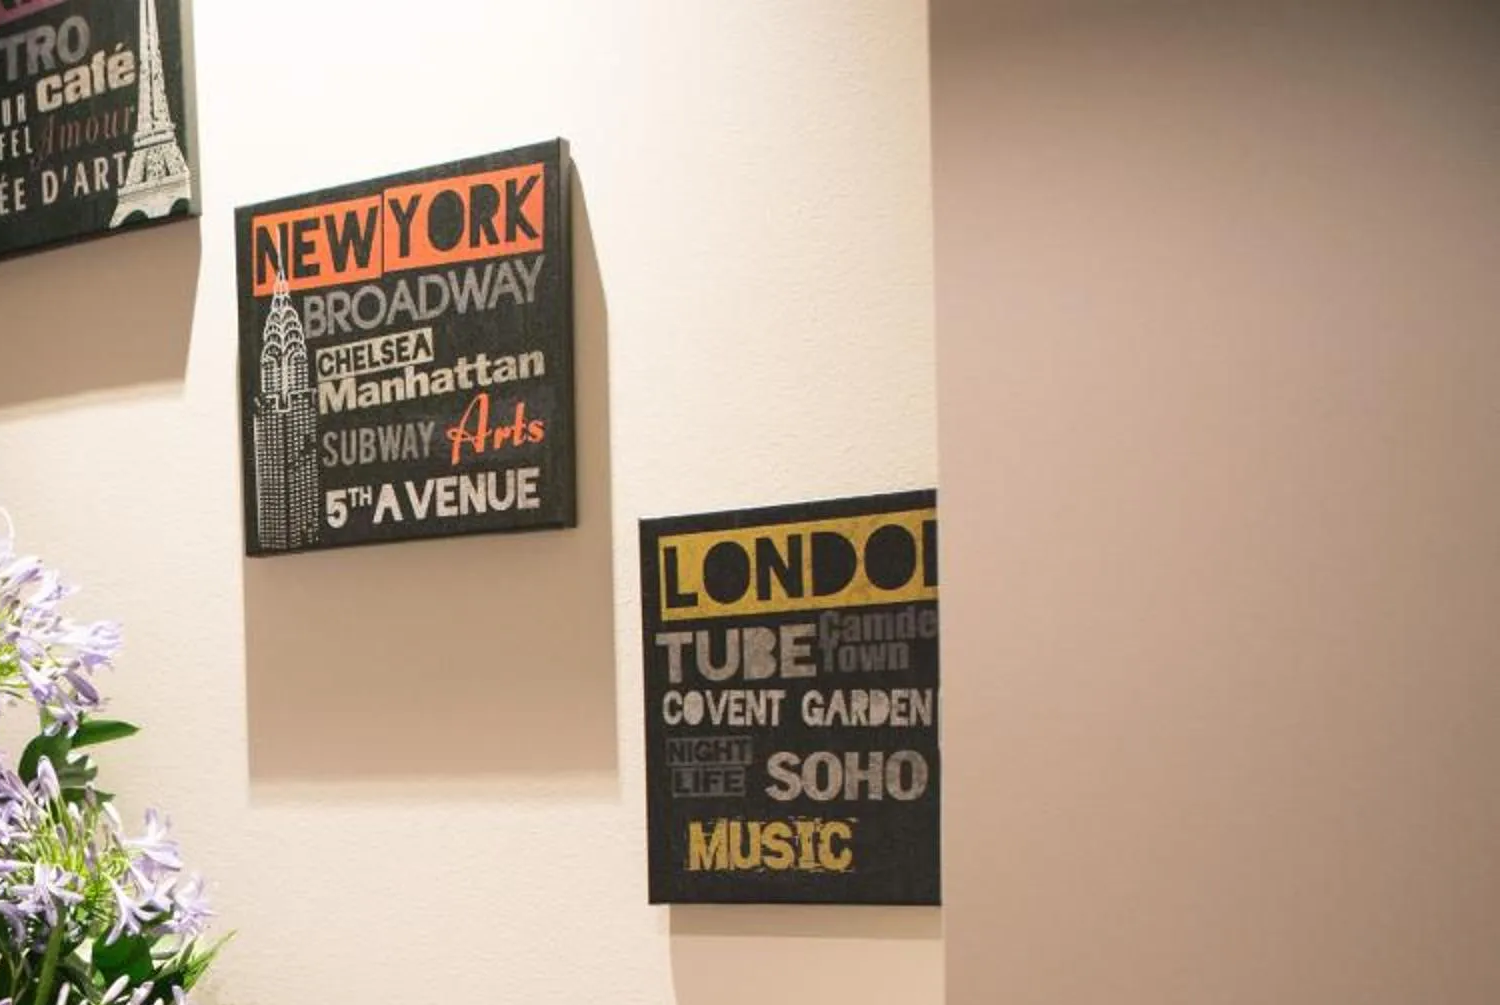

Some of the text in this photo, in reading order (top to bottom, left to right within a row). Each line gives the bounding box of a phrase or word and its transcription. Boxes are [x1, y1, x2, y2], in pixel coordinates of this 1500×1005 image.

[41, 151, 127, 205] D'ART
[255, 175, 540, 286] NEW YORK
[303, 255, 545, 338] BROADWAY
[317, 330, 432, 378] CHELSEA
[318, 350, 546, 415] Manhattan
[322, 392, 545, 467] SUBWAY Arts
[325, 467, 540, 530] 5TH AVENUE
[656, 623, 817, 684] TUBE
[817, 636, 909, 673] Town
[662, 687, 933, 728] COVENT GARDEN
[668, 738, 748, 763] NIGHT
[764, 750, 929, 801] SOHO
[674, 769, 744, 794] LIFE
[688, 817, 855, 873] MUSIC
